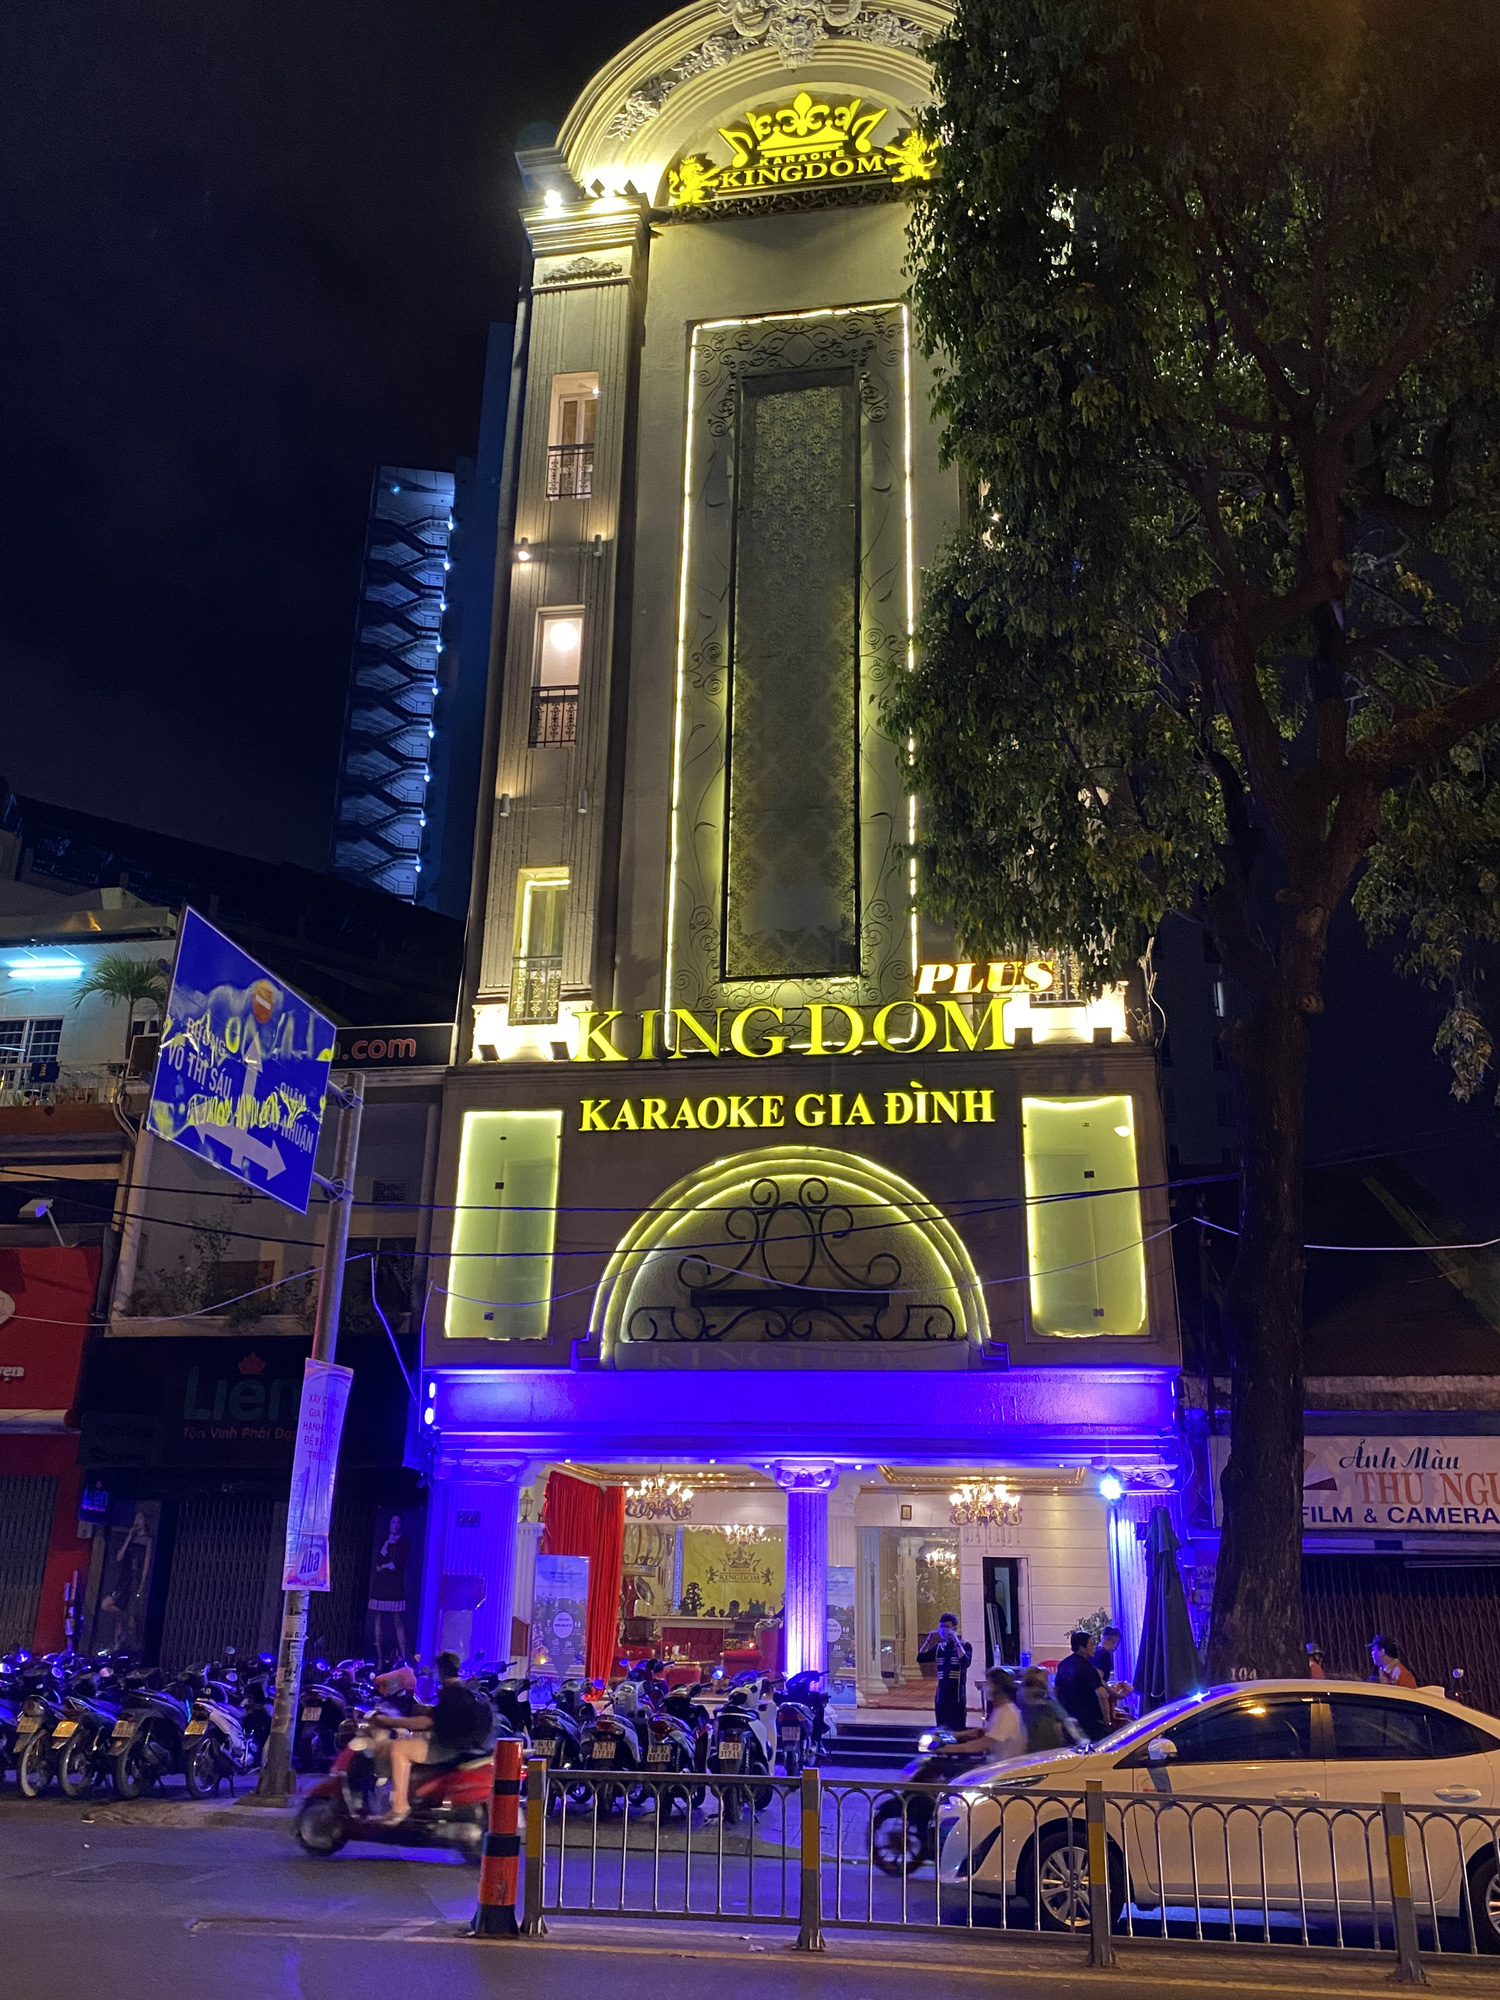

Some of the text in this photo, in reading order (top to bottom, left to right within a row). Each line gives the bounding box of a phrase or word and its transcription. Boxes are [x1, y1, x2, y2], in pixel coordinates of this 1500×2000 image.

[719, 155, 886, 188] KINGDOM
[760, 149, 845, 166] KARAOKE
[916, 960, 1054, 995] PLUS
[572, 997, 1014, 1063] KINGDOM
[209, 1068, 232, 1100] SÁU
[579, 1081, 996, 1131] KARAOKE GIA ĐÌNH
[211, 1427, 237, 1439] Vinh
[1338, 1438, 1462, 1470] Ảnh Màu
[1355, 1471, 1424, 1505] THU
[1364, 1508, 1378, 1523] &
[1387, 1507, 1500, 1524] CAMERA
[299, 1549, 320, 1574] Aba
[719, 1574, 760, 1582] KINGDOM
[1230, 1667, 1258, 1681] 104
